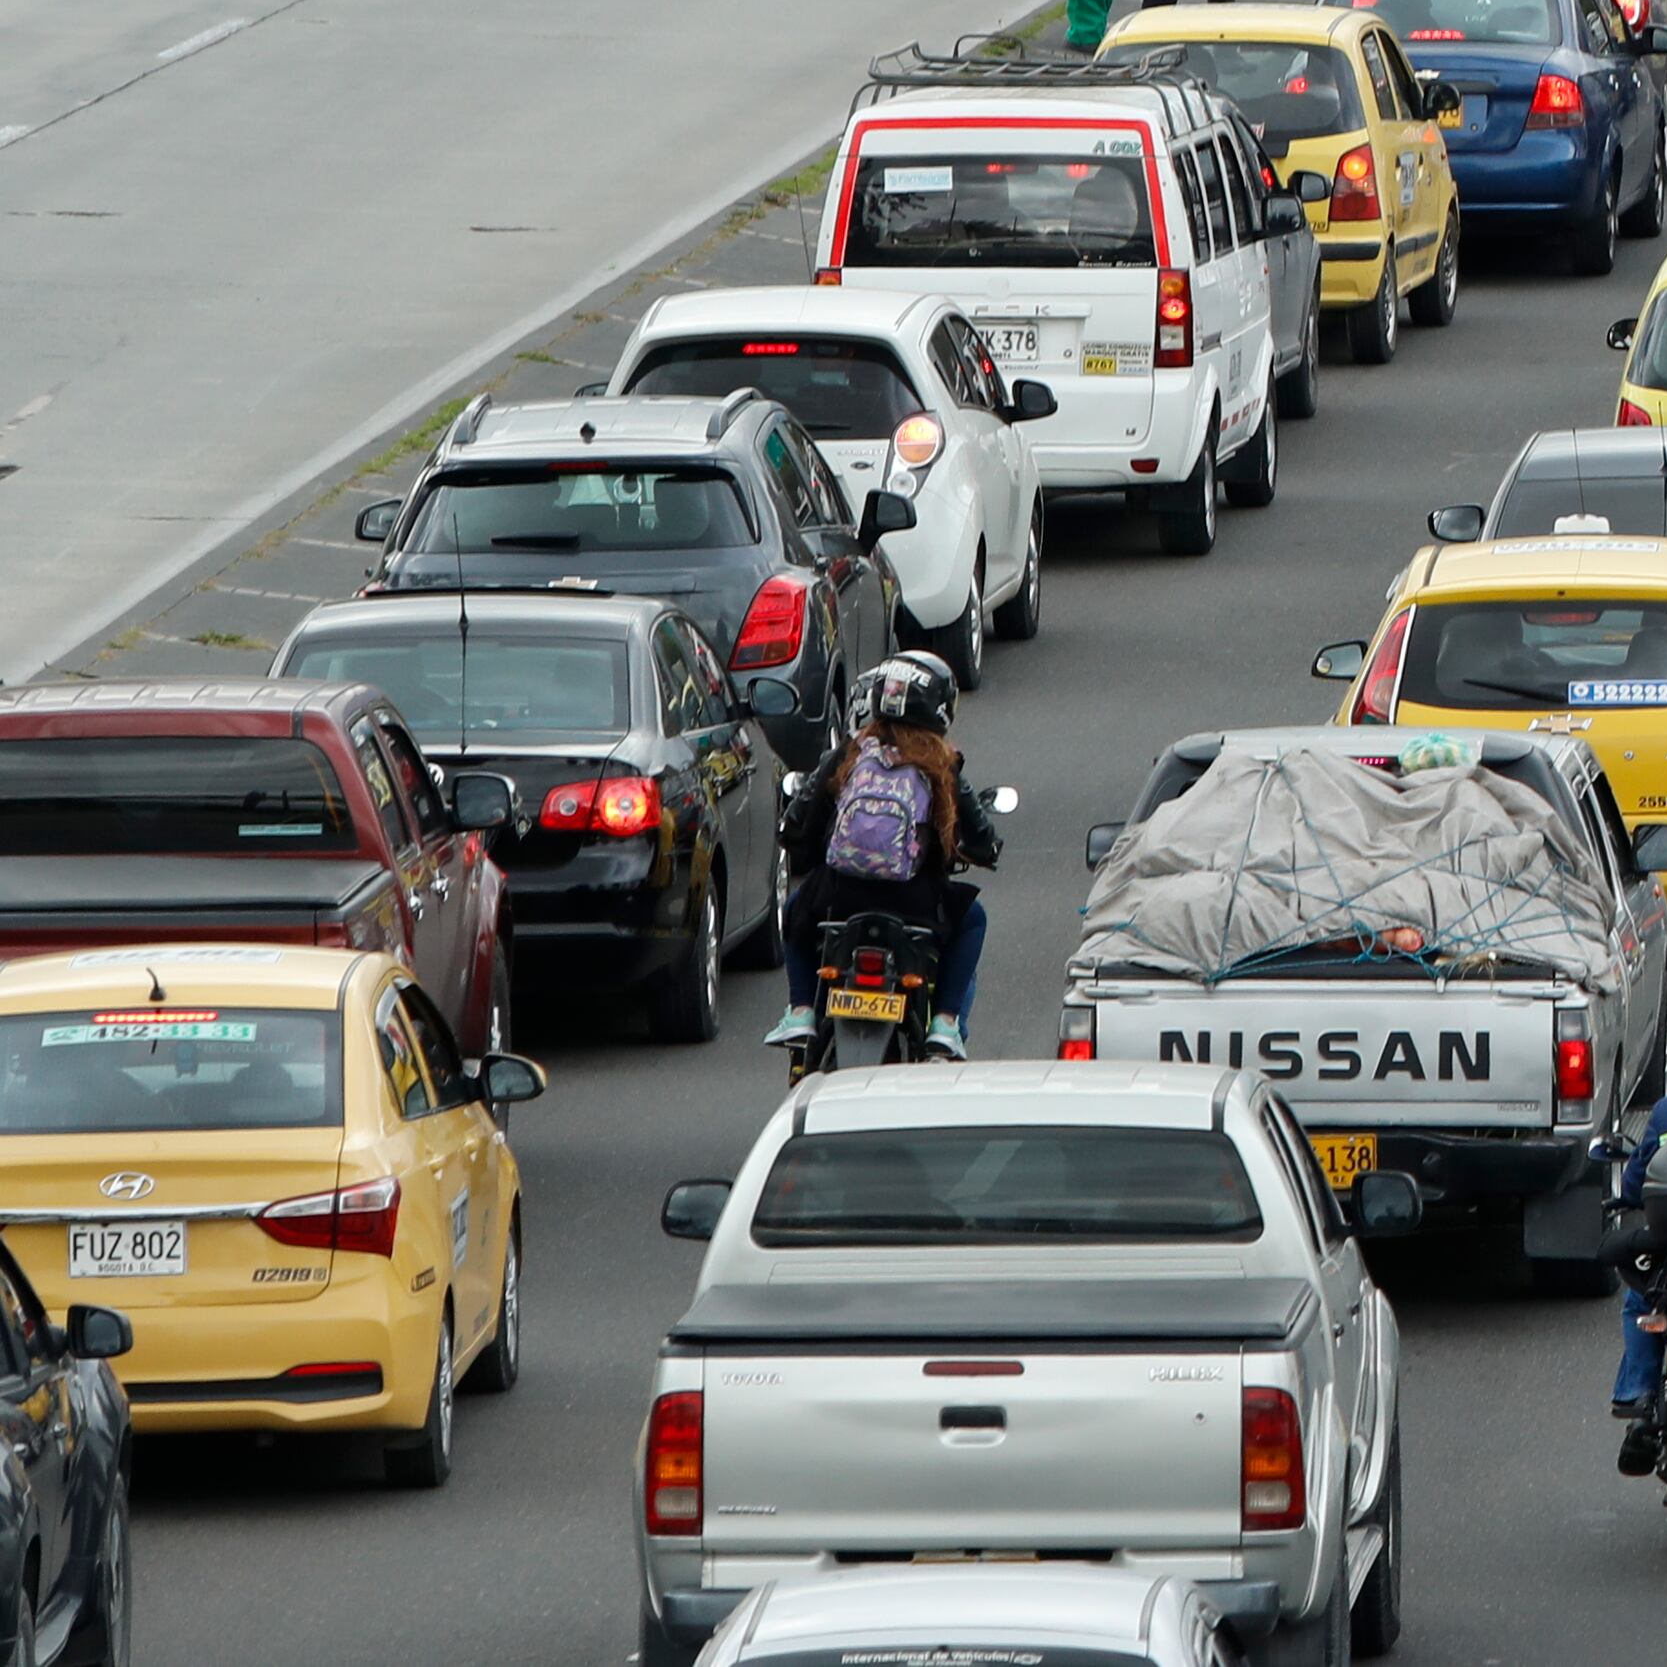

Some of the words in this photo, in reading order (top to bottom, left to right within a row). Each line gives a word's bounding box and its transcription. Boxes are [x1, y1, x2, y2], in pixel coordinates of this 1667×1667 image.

[1159, 1030, 1491, 1081] NISSAN
[72, 1230, 181, 1262] FUZ·802
[252, 1268, 312, 1283] 02919
[722, 1372, 784, 1386] TOYOTA
[842, 1651, 931, 1665] Internacional
[932, 1651, 950, 1662] de
